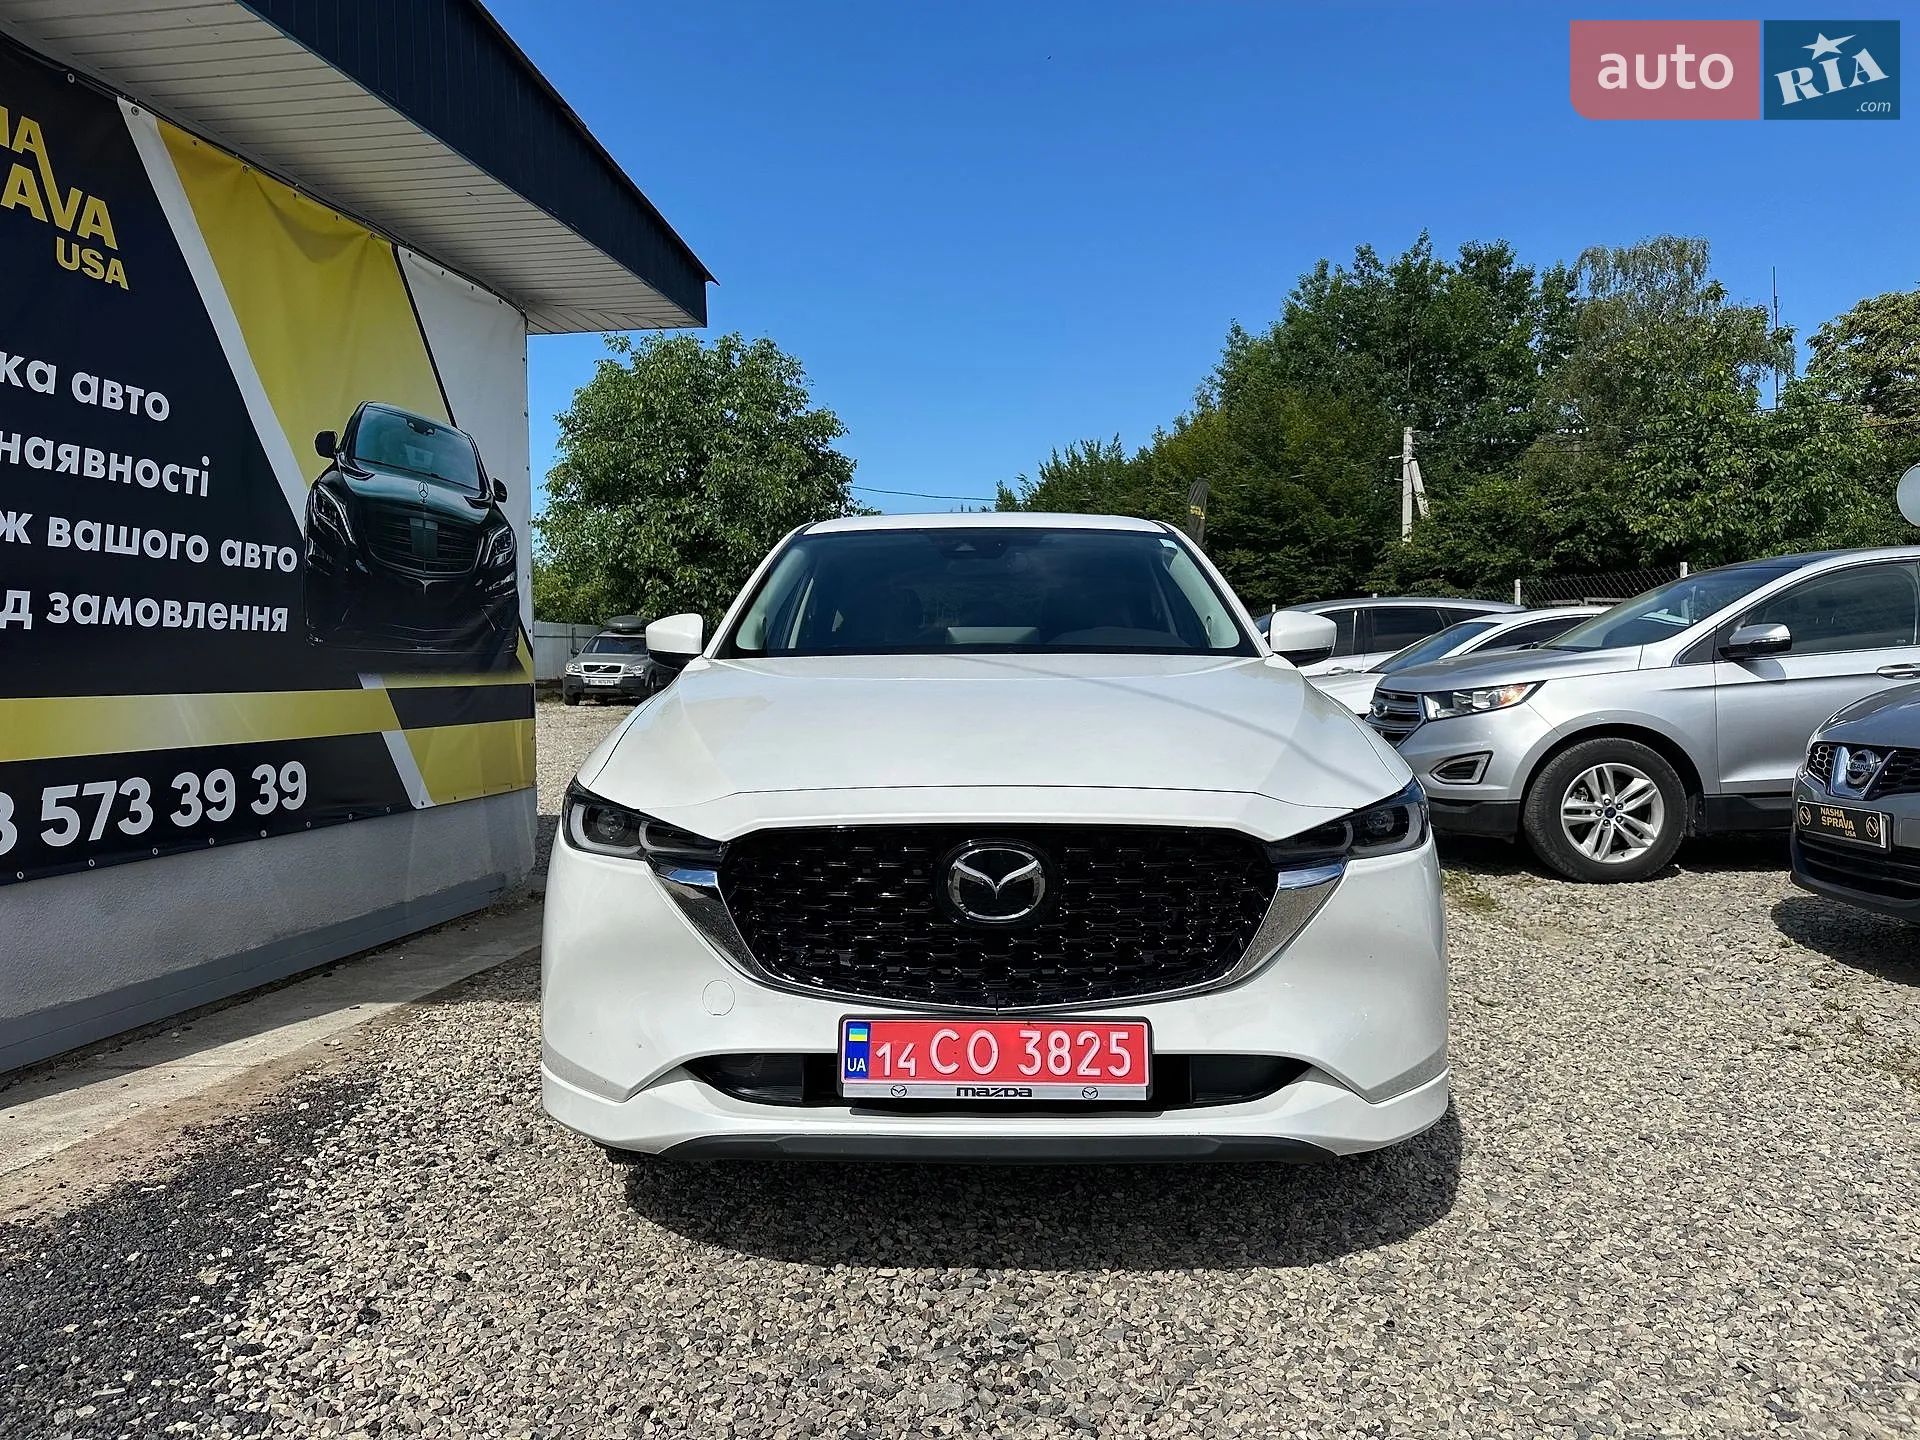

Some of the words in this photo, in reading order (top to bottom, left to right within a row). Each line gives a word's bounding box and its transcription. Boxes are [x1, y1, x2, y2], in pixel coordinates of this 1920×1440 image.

[56, 236, 129, 290] USA
[71, 371, 170, 422] авто
[0, 430, 209, 497] наявності
[47, 517, 208, 564] вашого
[220, 538, 298, 573] авто
[46, 592, 289, 633] замовлення
[40, 777, 154, 847] 573
[170, 768, 236, 828] 39
[250, 761, 307, 816] 39
[1820, 807, 1845, 818] NASHA
[1821, 815, 1855, 831] SPRAVA
[1844, 830, 1857, 838] USA
[847, 1057, 867, 1072] UA
[875, 1042, 917, 1077] 14
[929, 1028, 999, 1075] CO
[1018, 1029, 1132, 1077] 3825
